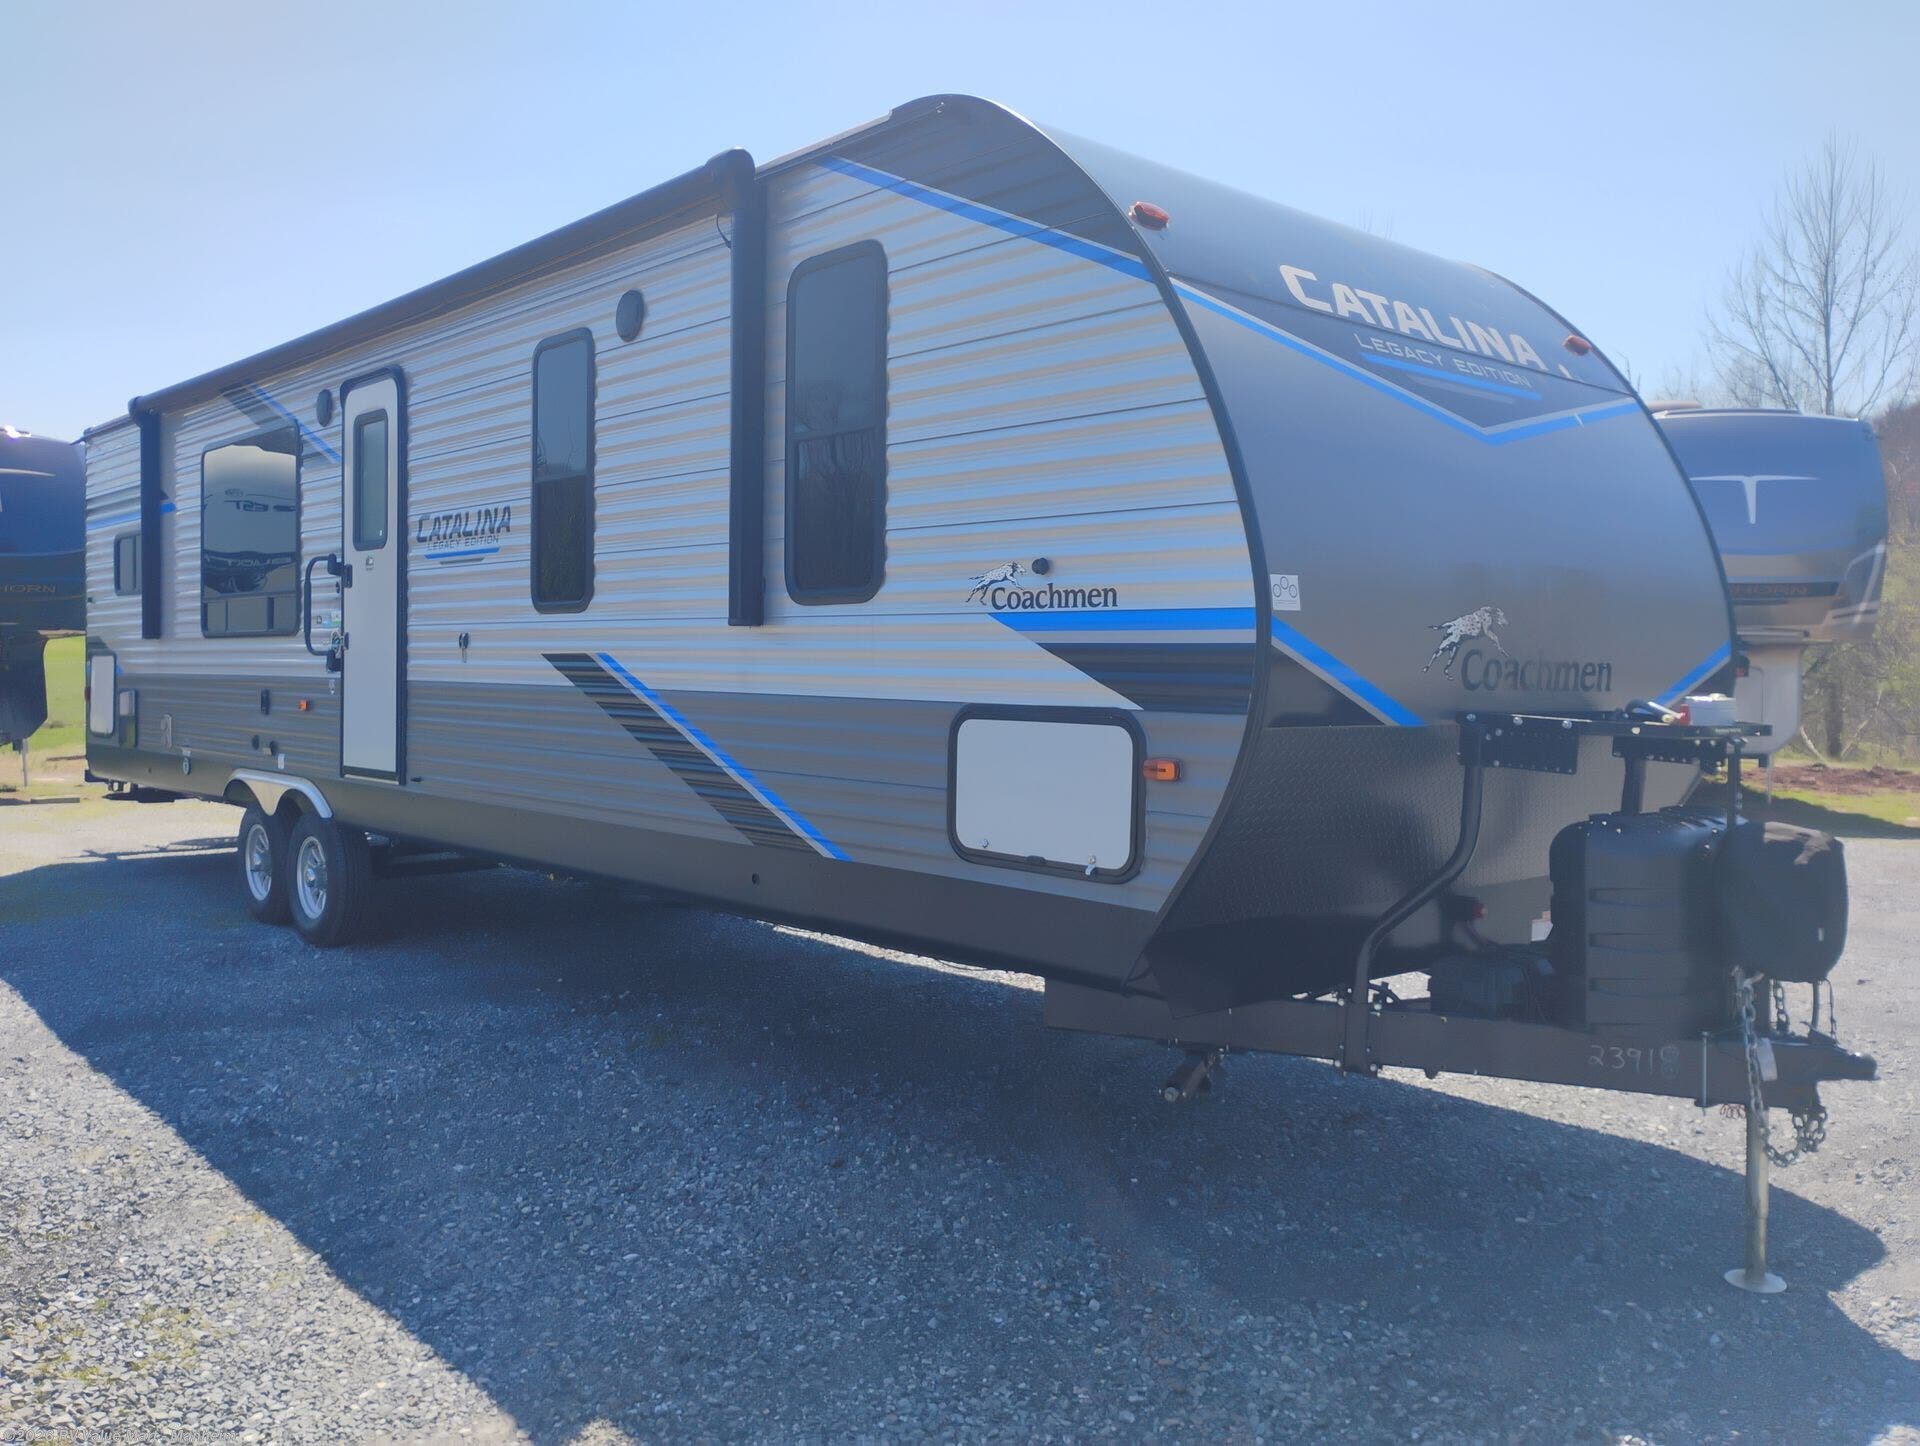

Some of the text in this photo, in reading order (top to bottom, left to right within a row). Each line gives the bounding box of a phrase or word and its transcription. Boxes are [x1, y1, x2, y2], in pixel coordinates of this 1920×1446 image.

[1280, 264, 1549, 371] CATALINA
[1354, 332, 1534, 389] LEGACY EDITION
[416, 505, 511, 543] CATALINA
[464, 535, 499, 547] EDITION
[991, 582, 1118, 610] Coachmen
[1461, 648, 1612, 692] Coachmen
